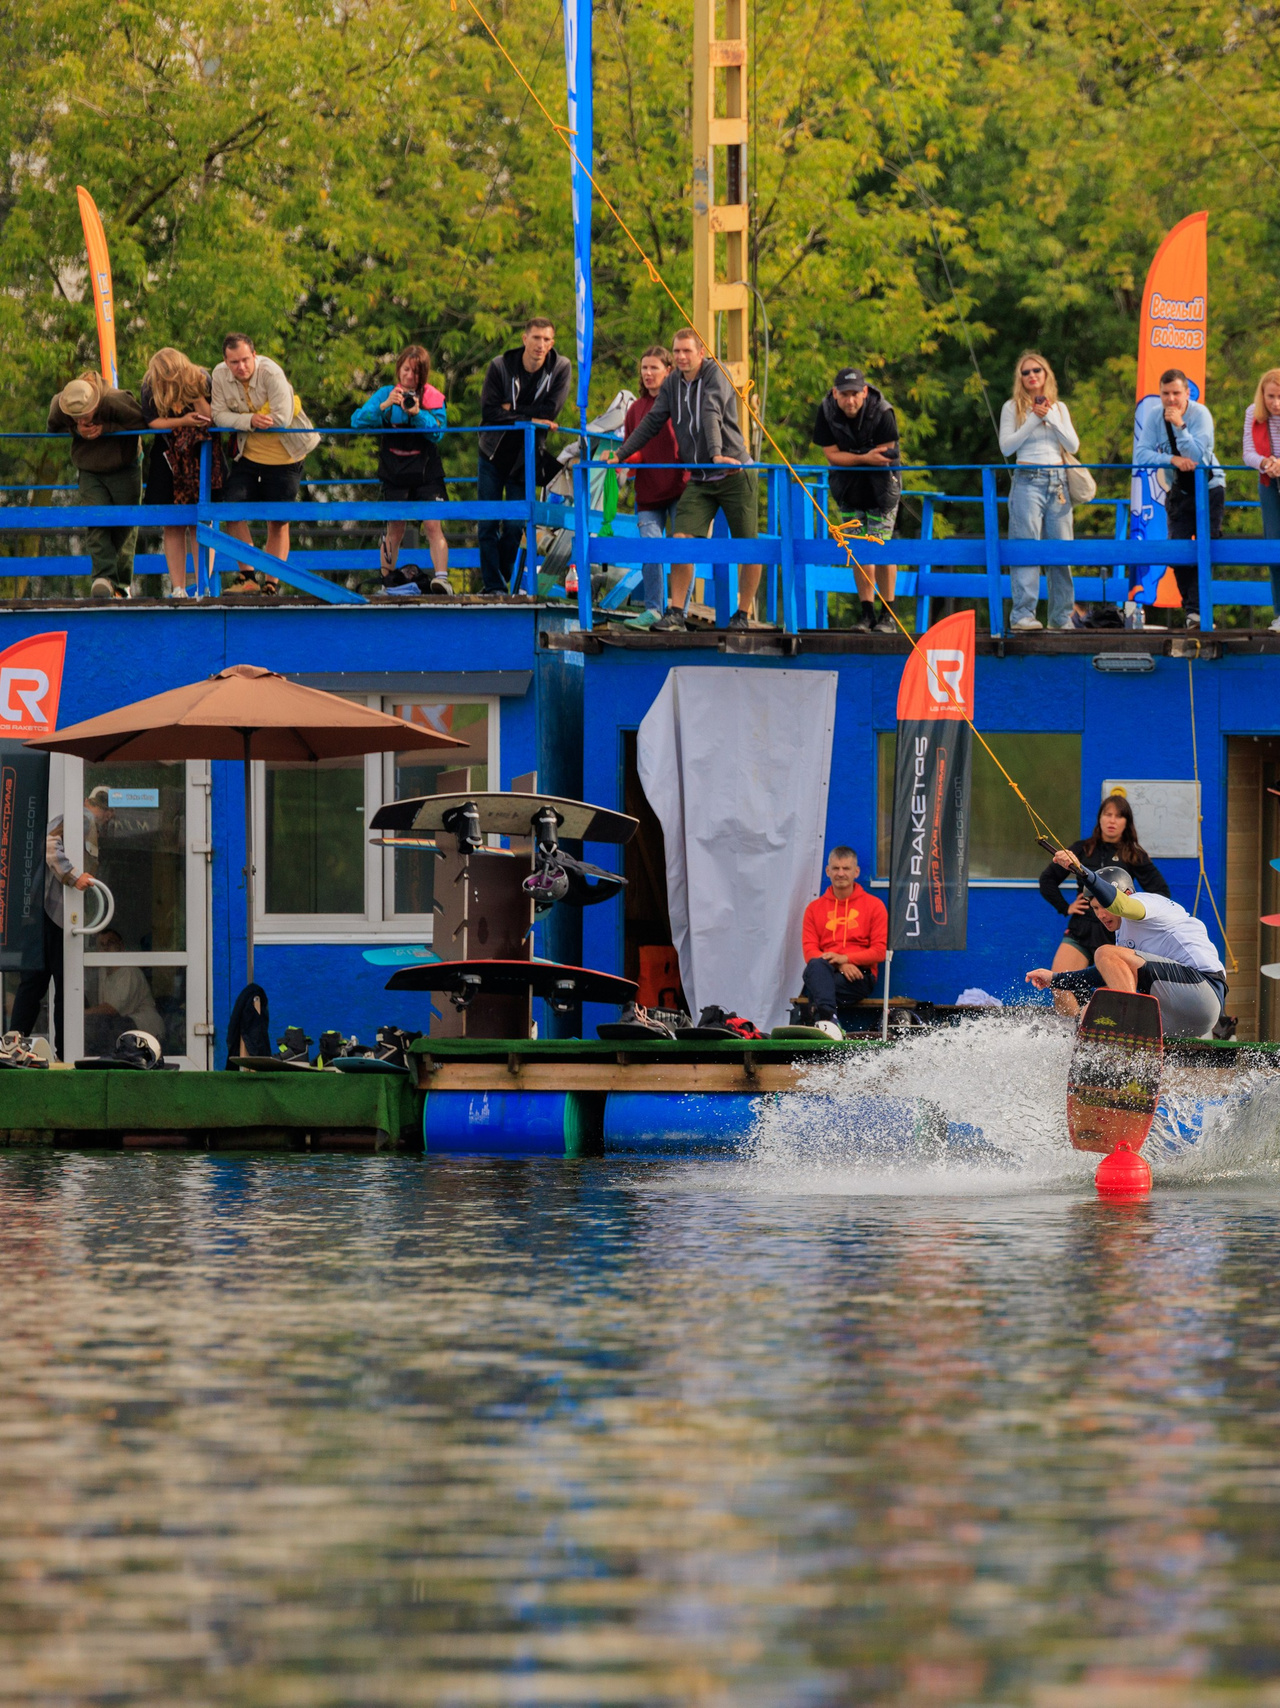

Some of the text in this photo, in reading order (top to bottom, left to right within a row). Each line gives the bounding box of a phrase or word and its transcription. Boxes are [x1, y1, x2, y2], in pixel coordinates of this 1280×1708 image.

[1151, 293, 1204, 321] Веселый
[21, 796, 37, 917] losraketos.com
[906, 736, 928, 937] LOS RAKETOS
